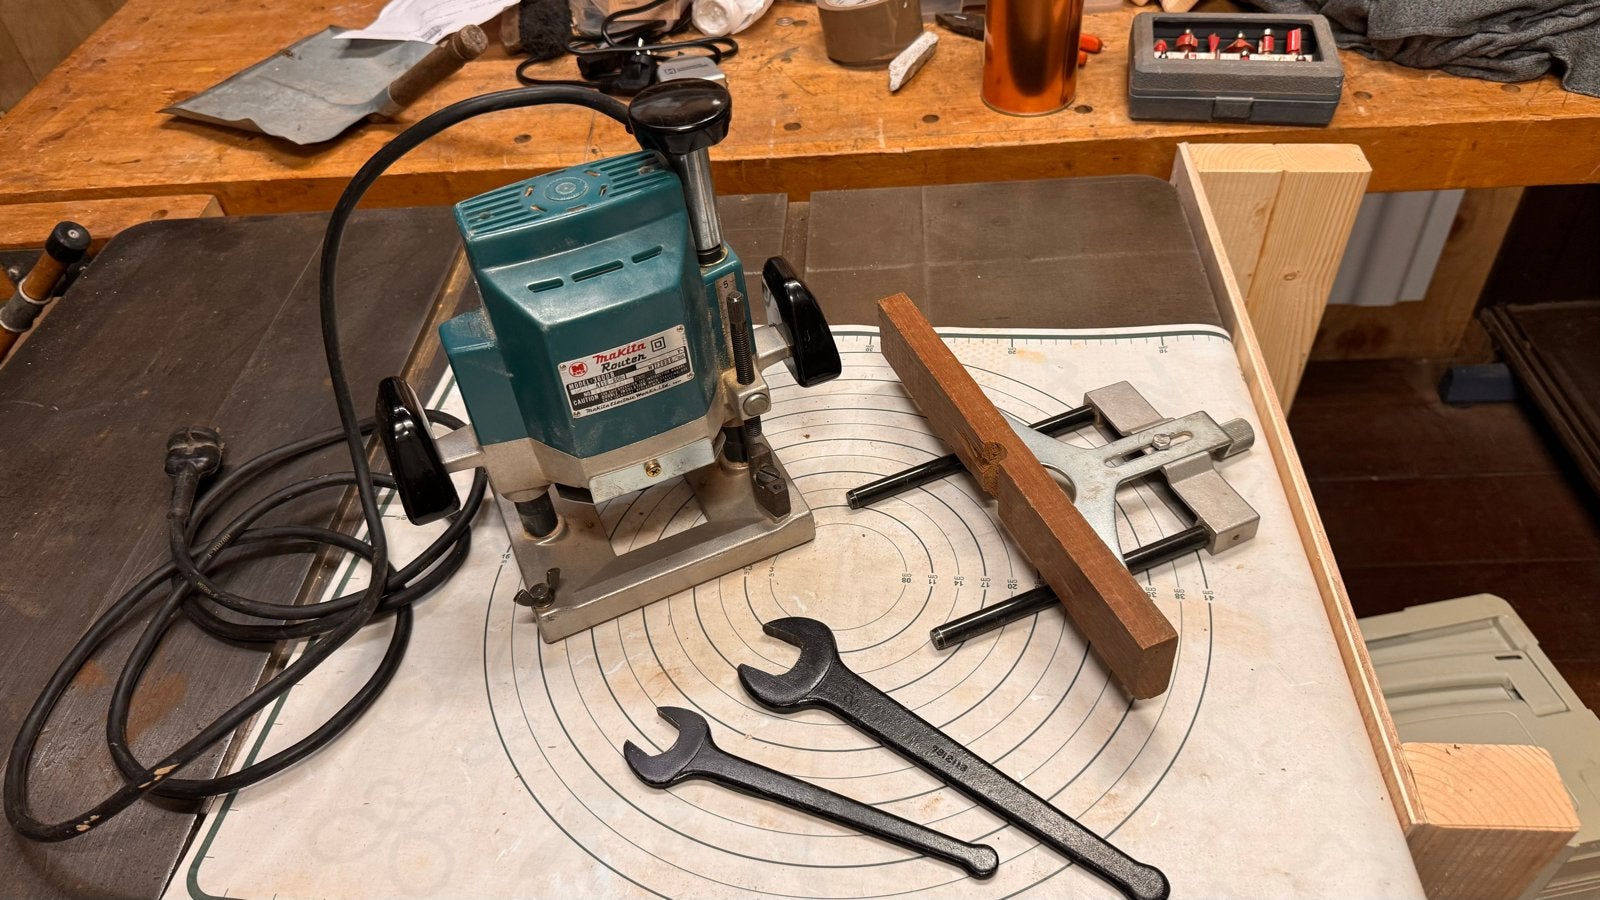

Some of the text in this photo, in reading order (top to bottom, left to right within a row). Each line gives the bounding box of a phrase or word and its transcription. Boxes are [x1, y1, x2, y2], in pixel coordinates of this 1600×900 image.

[723, 281, 729, 289] 5
[601, 354, 647, 374] Router
[573, 395, 600, 407] CAUTION
